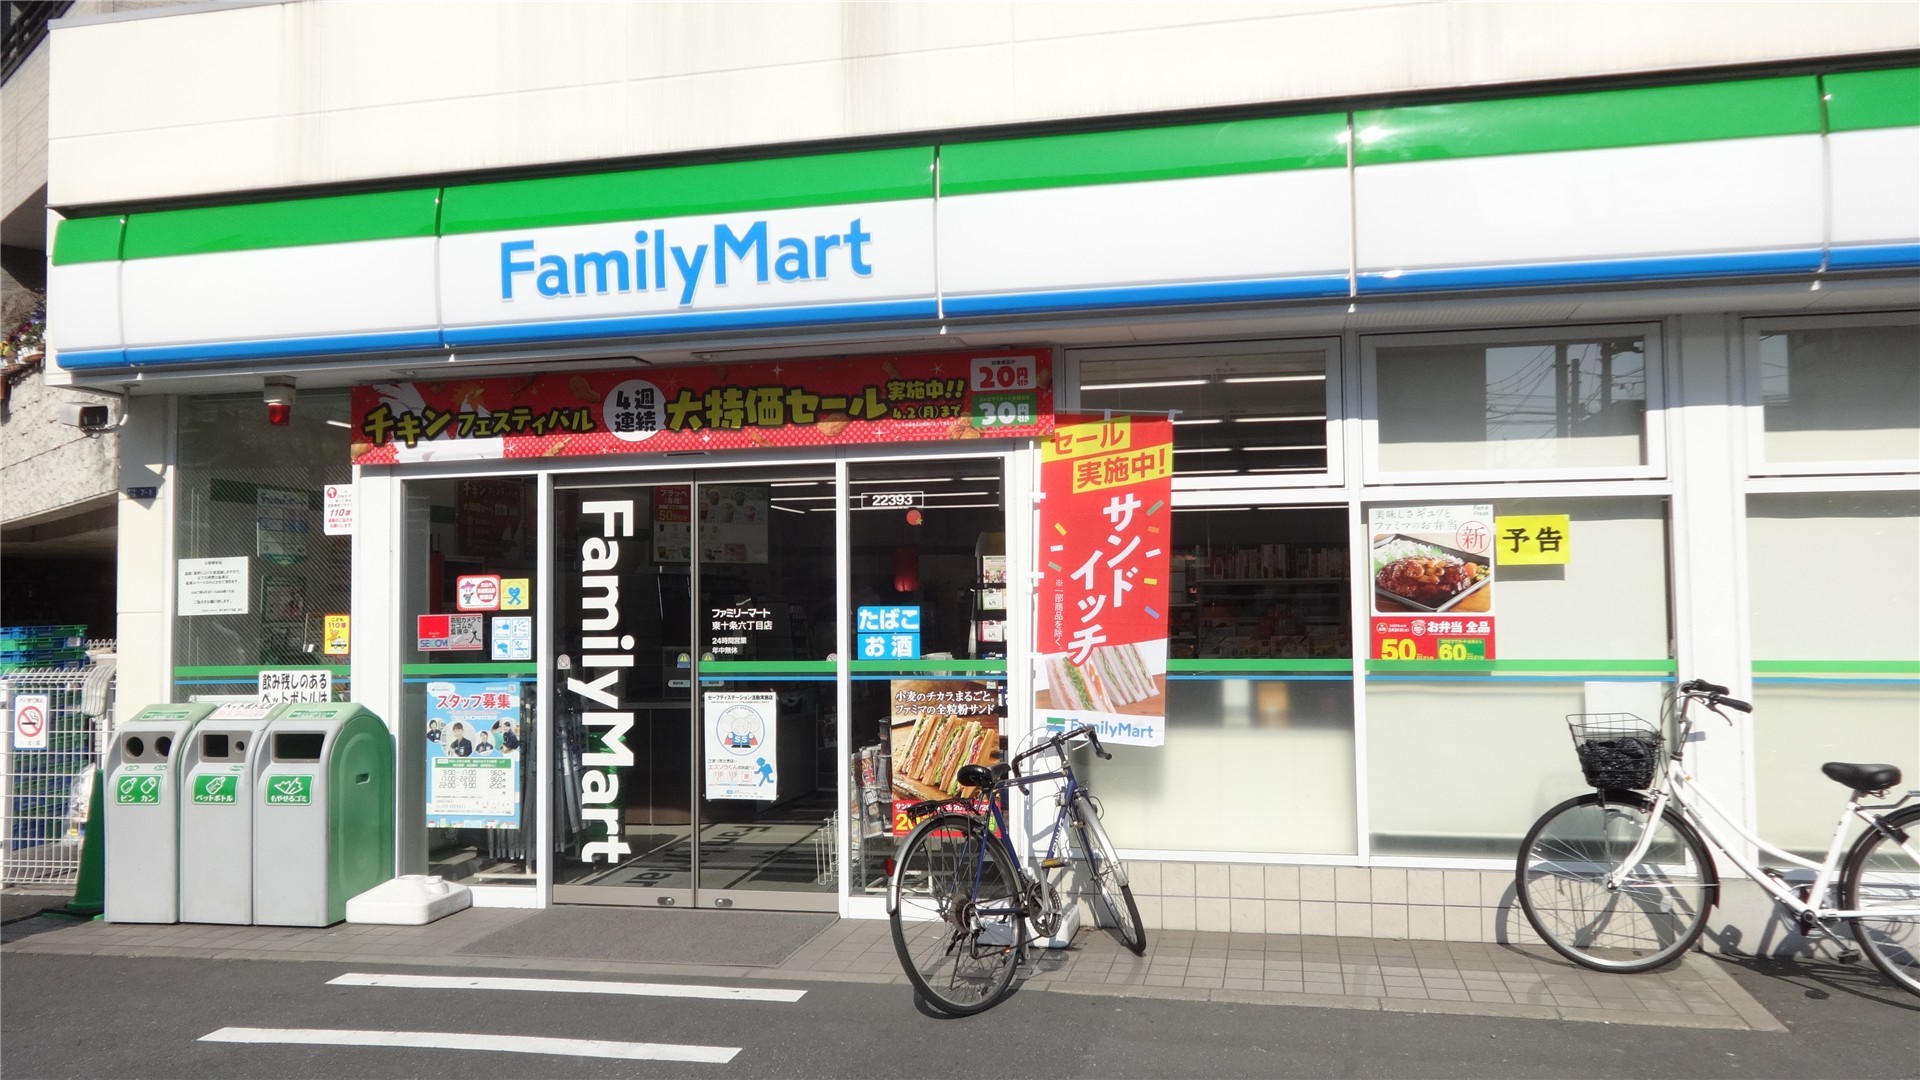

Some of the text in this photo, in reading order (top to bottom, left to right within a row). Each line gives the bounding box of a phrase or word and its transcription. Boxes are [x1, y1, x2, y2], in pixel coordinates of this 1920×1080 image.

[501, 218, 873, 306] FamilyMart
[615, 388, 655, 410] 4週
[888, 380, 964, 400] 実施中!!
[667, 387, 887, 430] 大特価セール
[614, 411, 656, 432] 連続
[1053, 421, 1124, 455] セール
[1077, 448, 1165, 489] 実施中!
[872, 495, 913, 506] 22393
[1375, 520, 1457, 530] ファミマのお弁当
[1462, 526, 1485, 549] 新
[1502, 526, 1563, 553] 予告
[1103, 493, 1141, 608] サンド
[711, 608, 770, 618] ファミリーマート
[1068, 550, 1107, 664] イッチ
[712, 620, 773, 630] 東十条六丁目店
[859, 609, 919, 630] たばこ
[1427, 621, 1462, 633] お弁当
[1466, 621, 1490, 633] 全品
[865, 635, 912, 658] お酒
[1382, 639, 1416, 660] 50
[1439, 644, 1466, 660] 60
[263, 674, 328, 690] 飲み残しのある
[567, 500, 634, 863] FamilyMart
[437, 693, 510, 708] スタッフ募集
[895, 691, 994, 702] 小麦のチカラ、まるごと。
[895, 704, 994, 715] ファミマの全粒粉サンド
